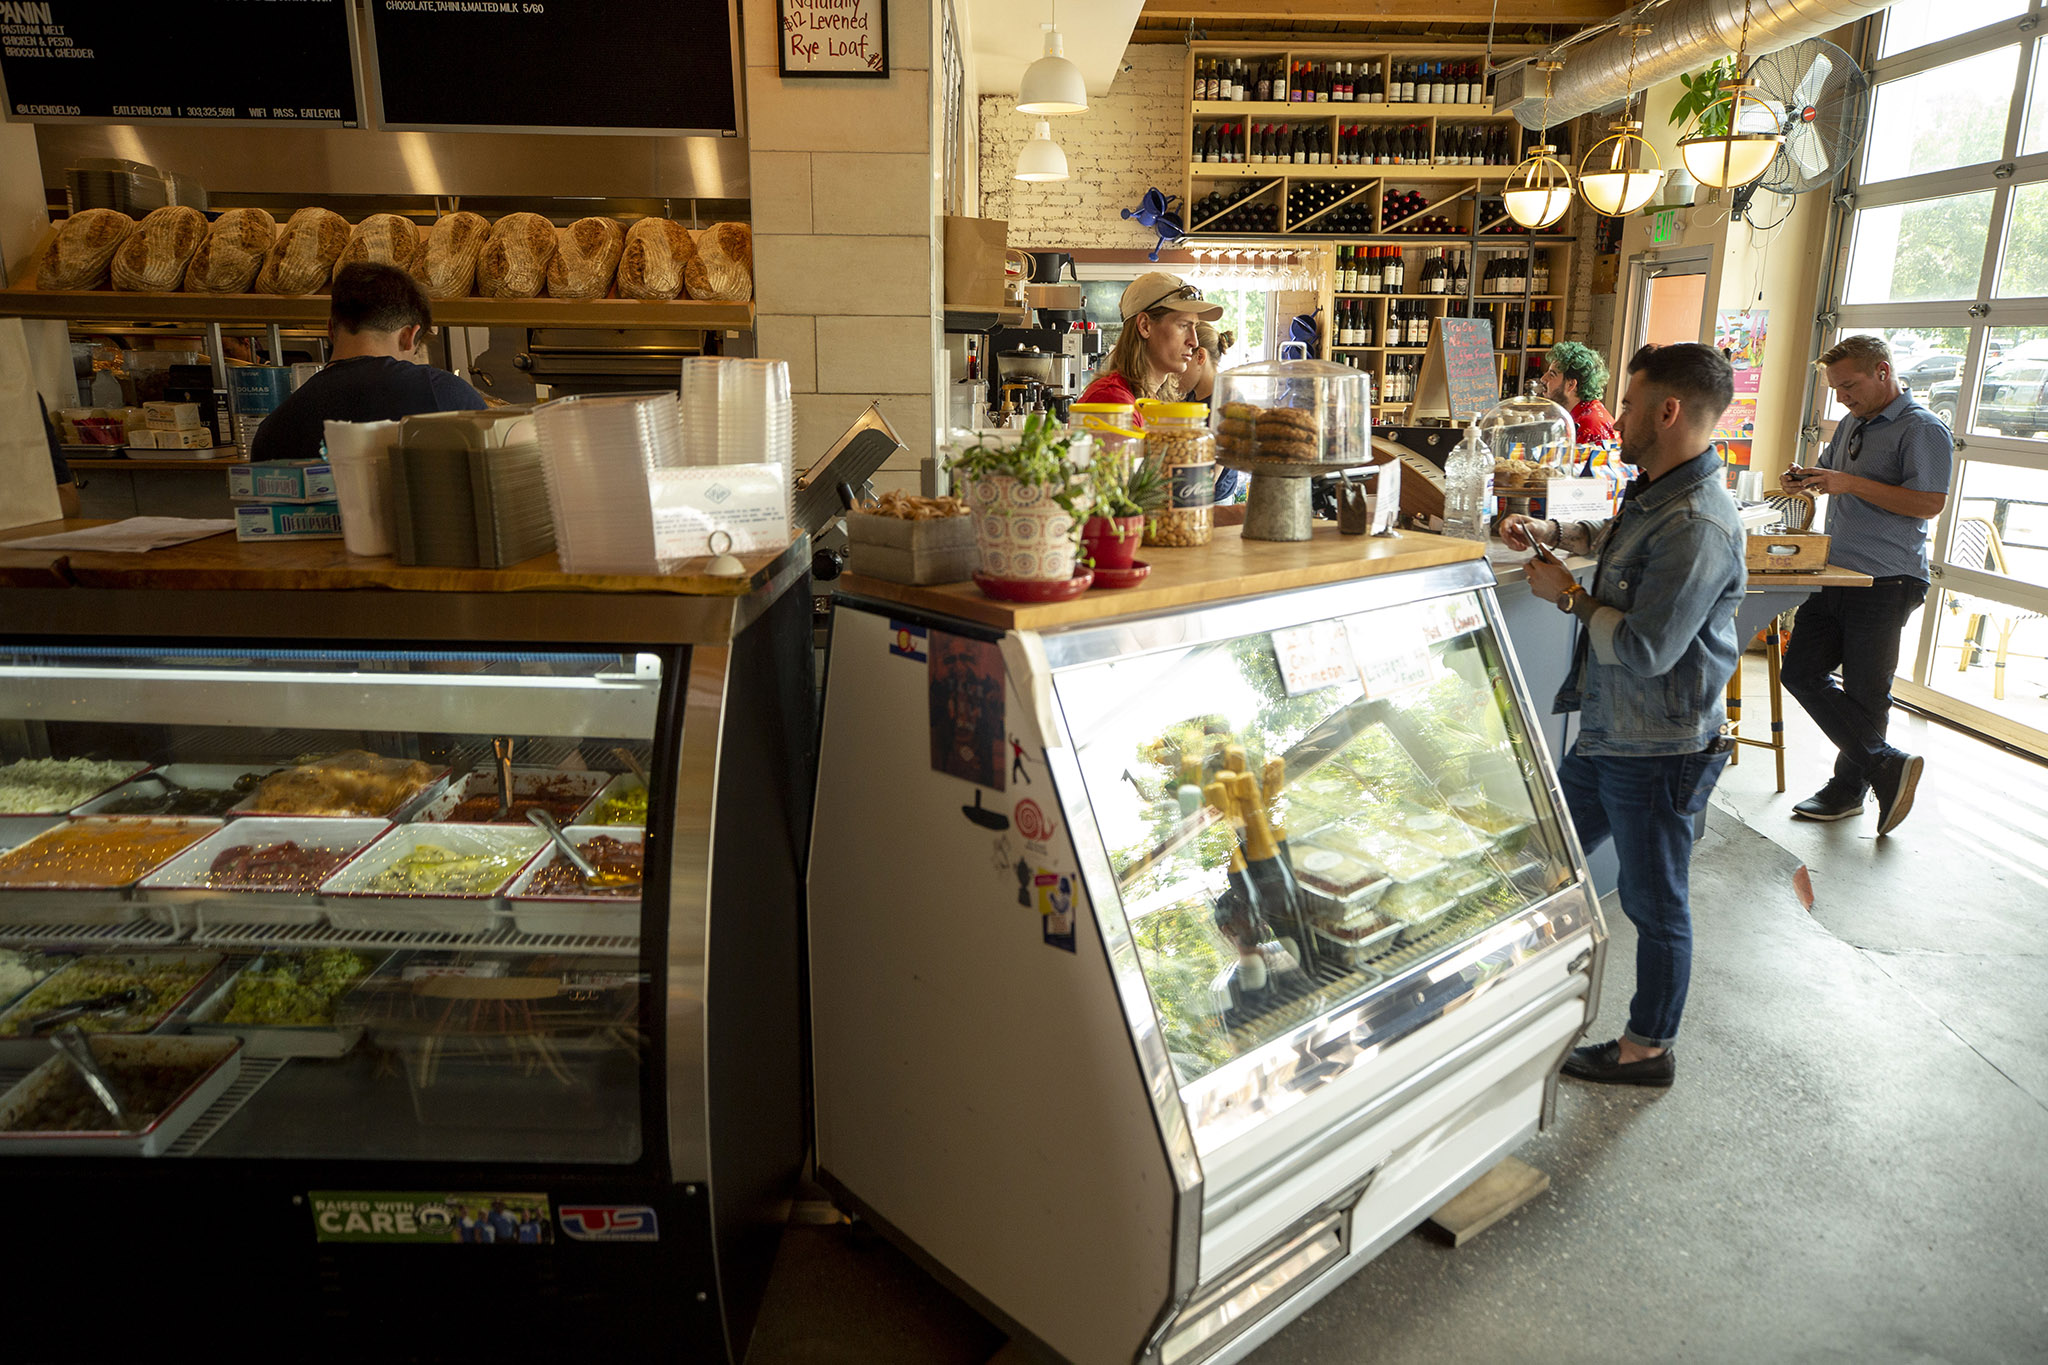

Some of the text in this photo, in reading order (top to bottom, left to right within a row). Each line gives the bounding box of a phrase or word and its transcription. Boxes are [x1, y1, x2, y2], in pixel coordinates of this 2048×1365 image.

[500, 3, 518, 13] MILK
[522, 4, 544, 14] 5/60
[810, 12, 868, 30] Levened
[42, 25, 65, 35] MELT
[2, 36, 37, 46] CHICKEN
[48, 37, 73, 47] PESTO
[5, 47, 45, 57] BROCCOLI
[791, 34, 869, 63] Rye Loaf
[249, 107, 267, 117] WIFI
[301, 108, 340, 118] EATLEVEN
[1654, 211, 1675, 242] EXIT
[316, 1201, 415, 1213] RAISED WITH
[318, 1210, 418, 1234] CARE
